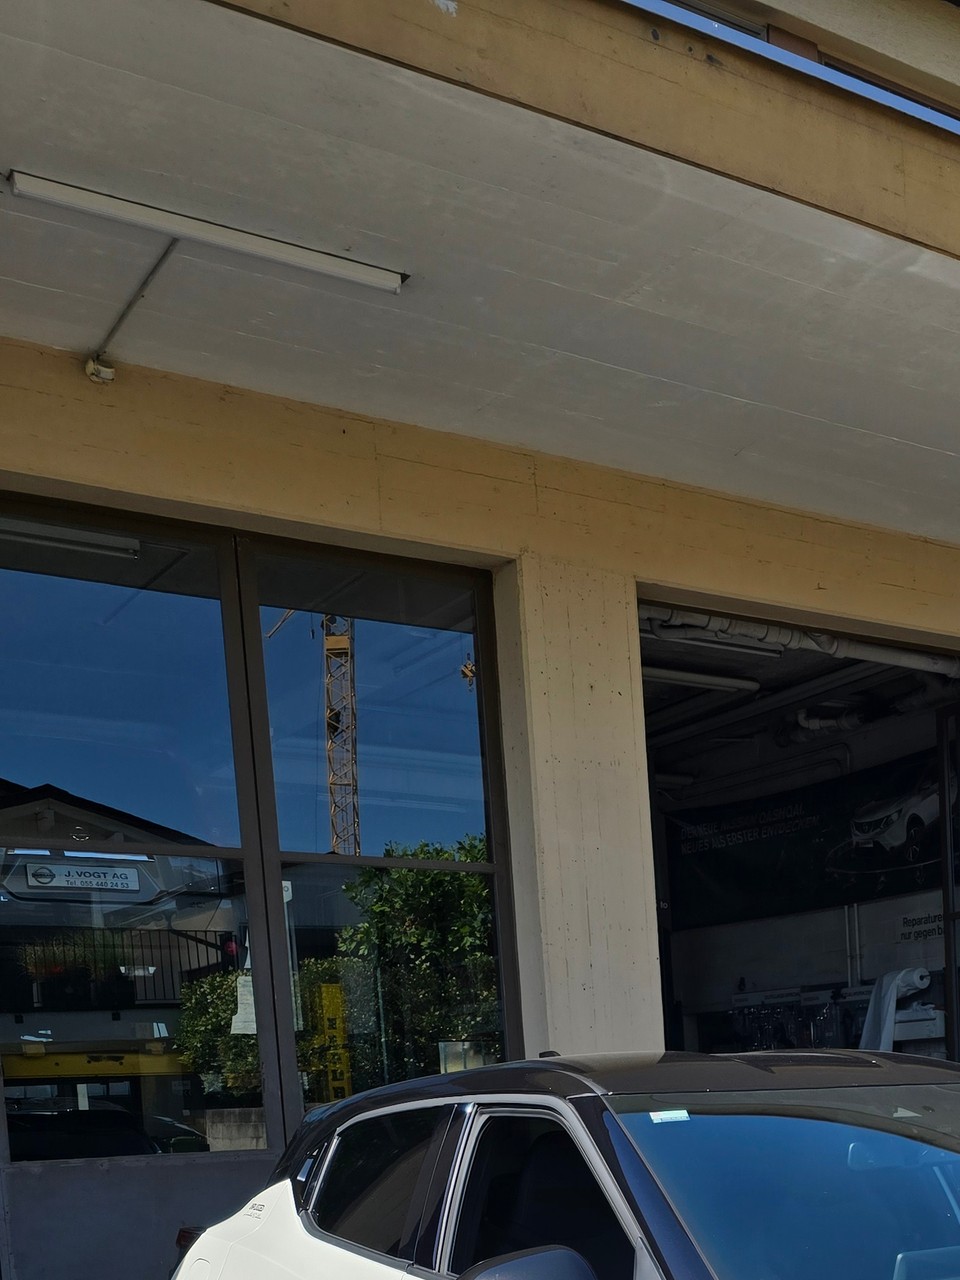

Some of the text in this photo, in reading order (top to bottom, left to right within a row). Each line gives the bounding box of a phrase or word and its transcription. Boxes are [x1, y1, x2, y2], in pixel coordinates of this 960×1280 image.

[728, 829, 760, 846] ERSTER
[64, 870, 129, 880] J. VOGT AG
[900, 931, 912, 940] nur
[913, 927, 936, 941] gegen
